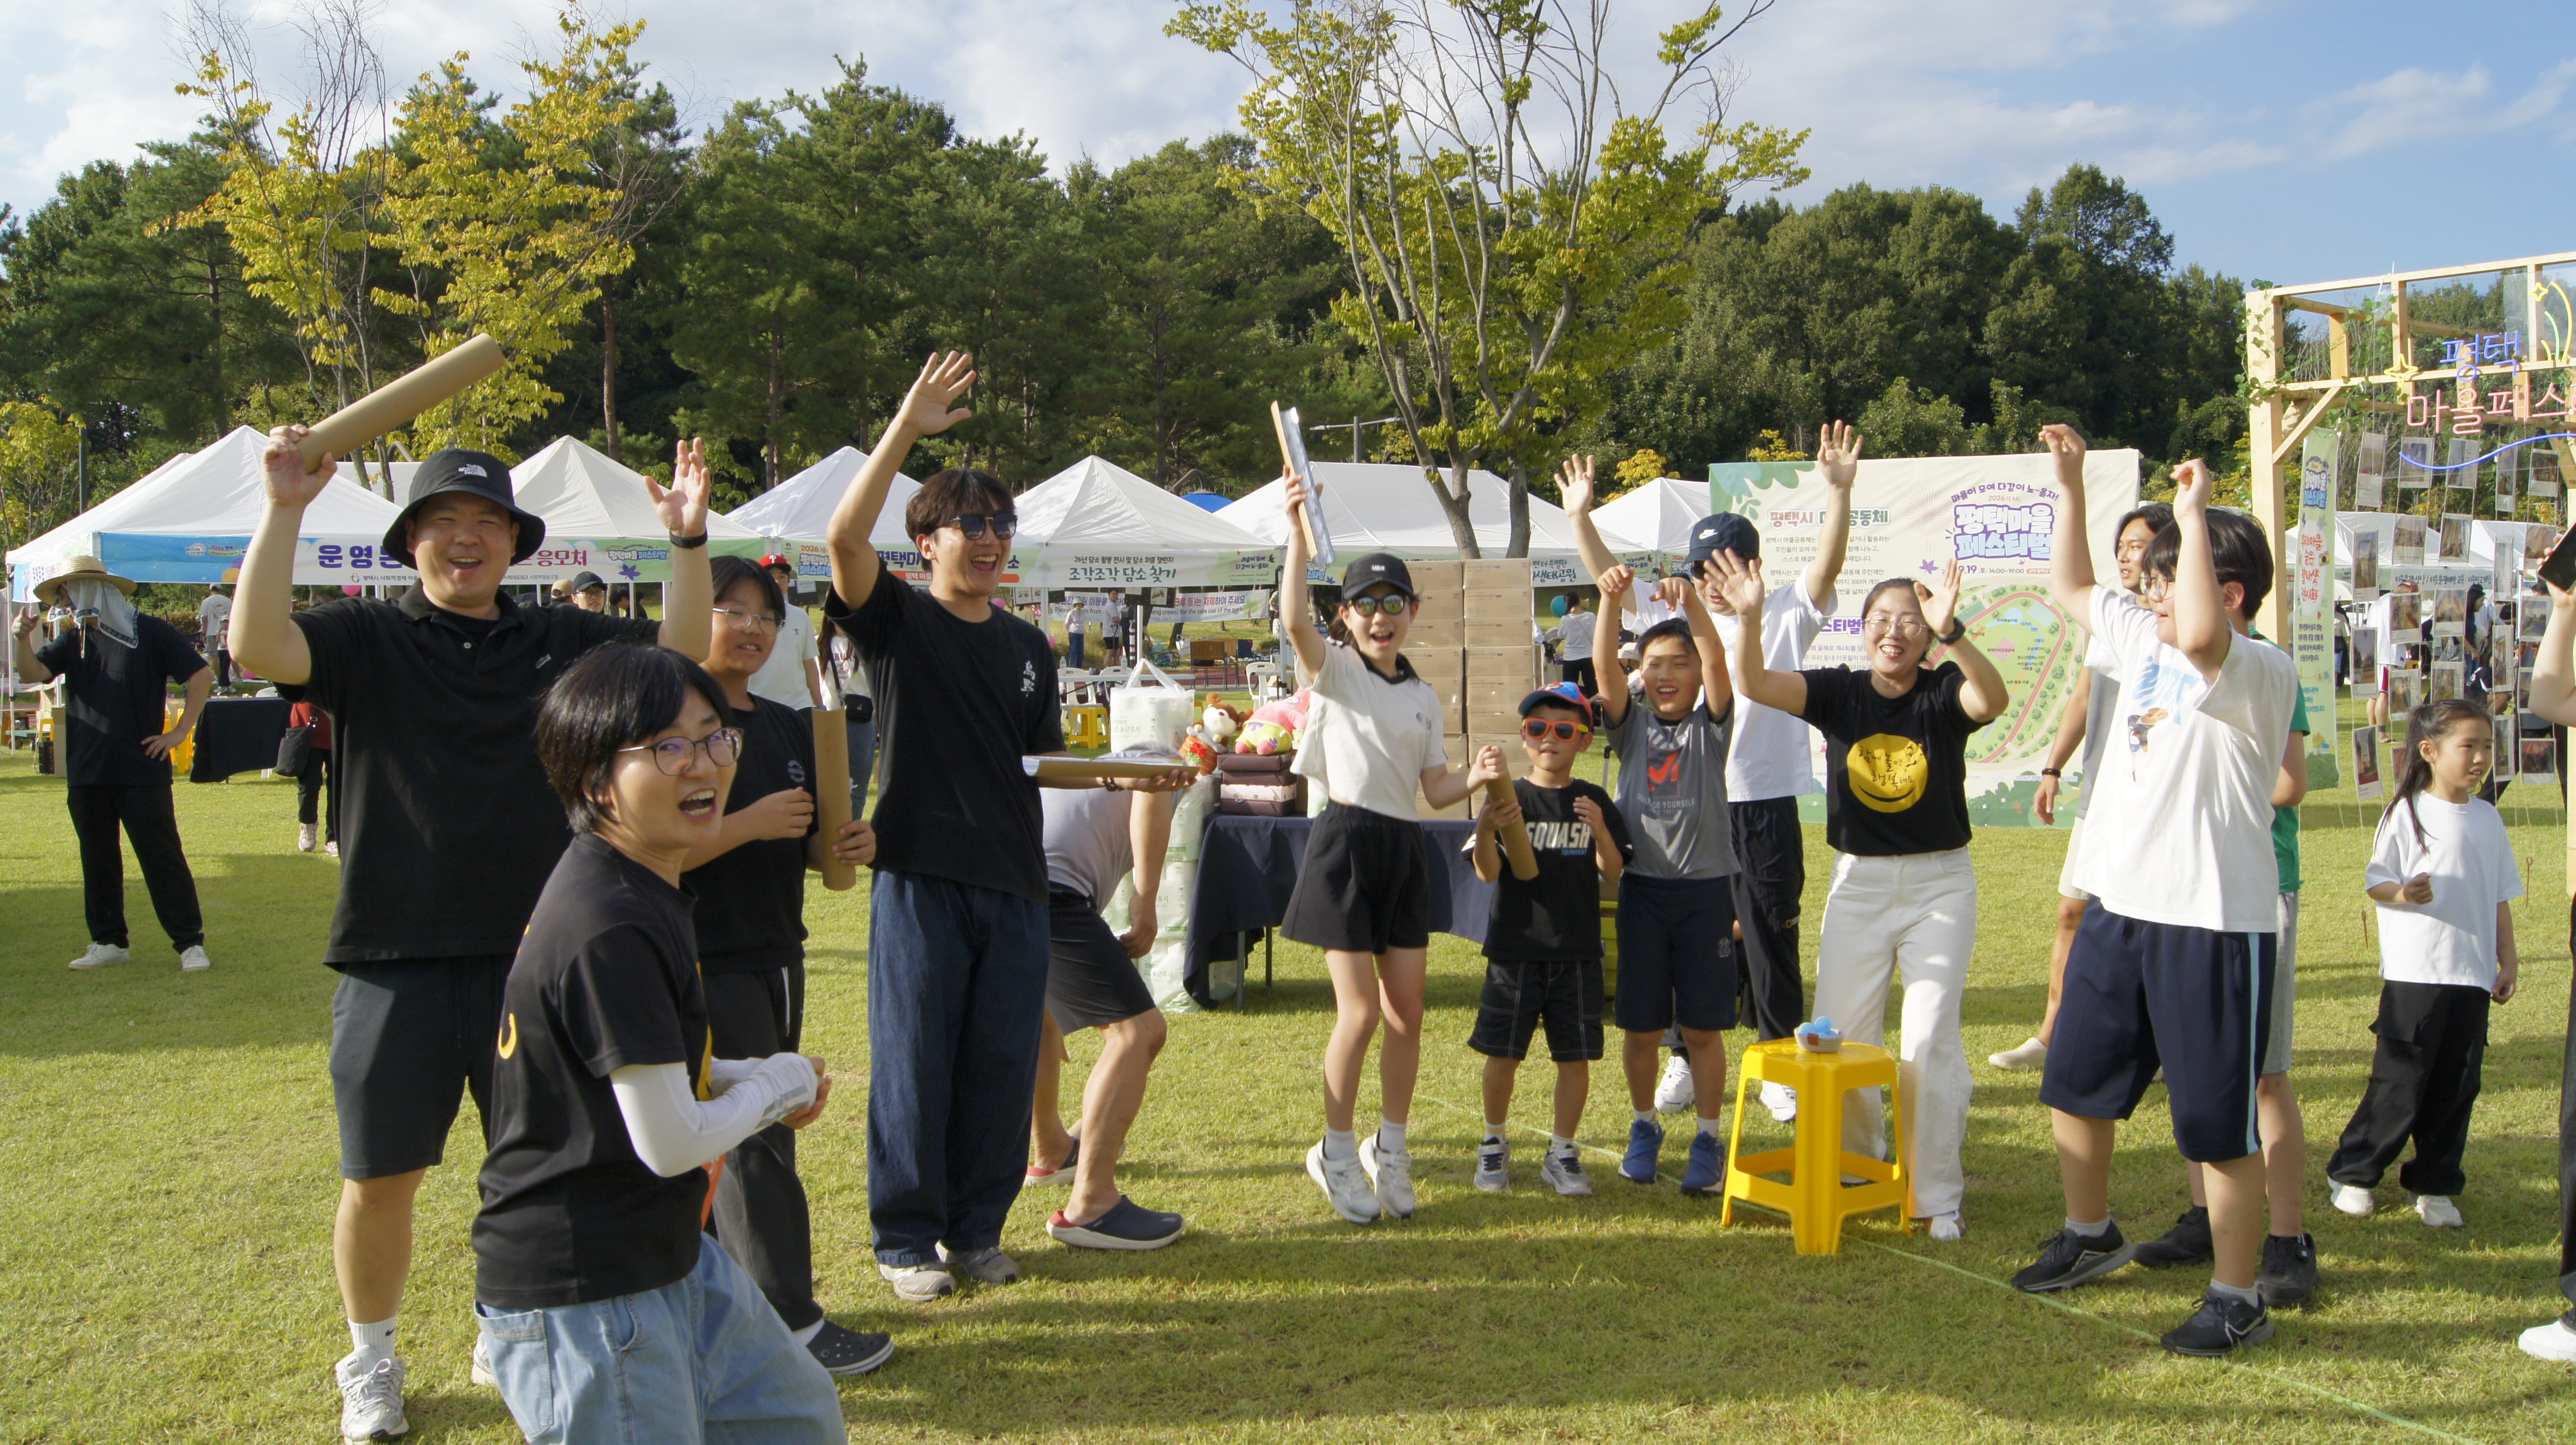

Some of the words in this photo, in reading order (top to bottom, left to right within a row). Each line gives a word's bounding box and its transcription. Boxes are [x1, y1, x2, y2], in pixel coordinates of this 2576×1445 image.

[2440, 330, 2520, 382] 평택
[1951, 487, 1977, 503] 마을이
[1979, 483, 1995, 494] 모여
[1998, 482, 2025, 492] 다같이
[2027, 485, 2060, 501] 노~올자!
[1769, 510, 1814, 528] 평택시
[1819, 509, 1889, 526] 공동체
[1954, 503, 2054, 535] 평택마을
[1954, 532, 2052, 560] 페스티벌
[2301, 533, 2323, 551] 우리마을
[537, 549, 588, 567] 응모처
[769, 555, 777, 564] P
[1101, 556, 1112, 564] 활동
[1113, 556, 1125, 564] 전시
[1126, 556, 1132, 564] 및
[1133, 556, 1144, 564] 담소
[1548, 558, 1567, 569] 특별한
[1069, 566, 1120, 582] 조각조각
[1123, 567, 1147, 582] 담소
[1149, 565, 1177, 583] 찾기
[1089, 596, 1108, 606] 이용을
[1187, 596, 1202, 607] 등)는
[1203, 596, 1227, 607] 자제하여
[1227, 595, 1246, 605] 주세요
[2301, 587, 2320, 602] 전시회
[1820, 619, 1861, 635] 스티벌
[1859, 745, 1882, 763] 함께
[1871, 770, 1915, 791] 행복해요
[1662, 798, 1695, 809] YOURSELF
[1525, 821, 1591, 852] SQUASH
